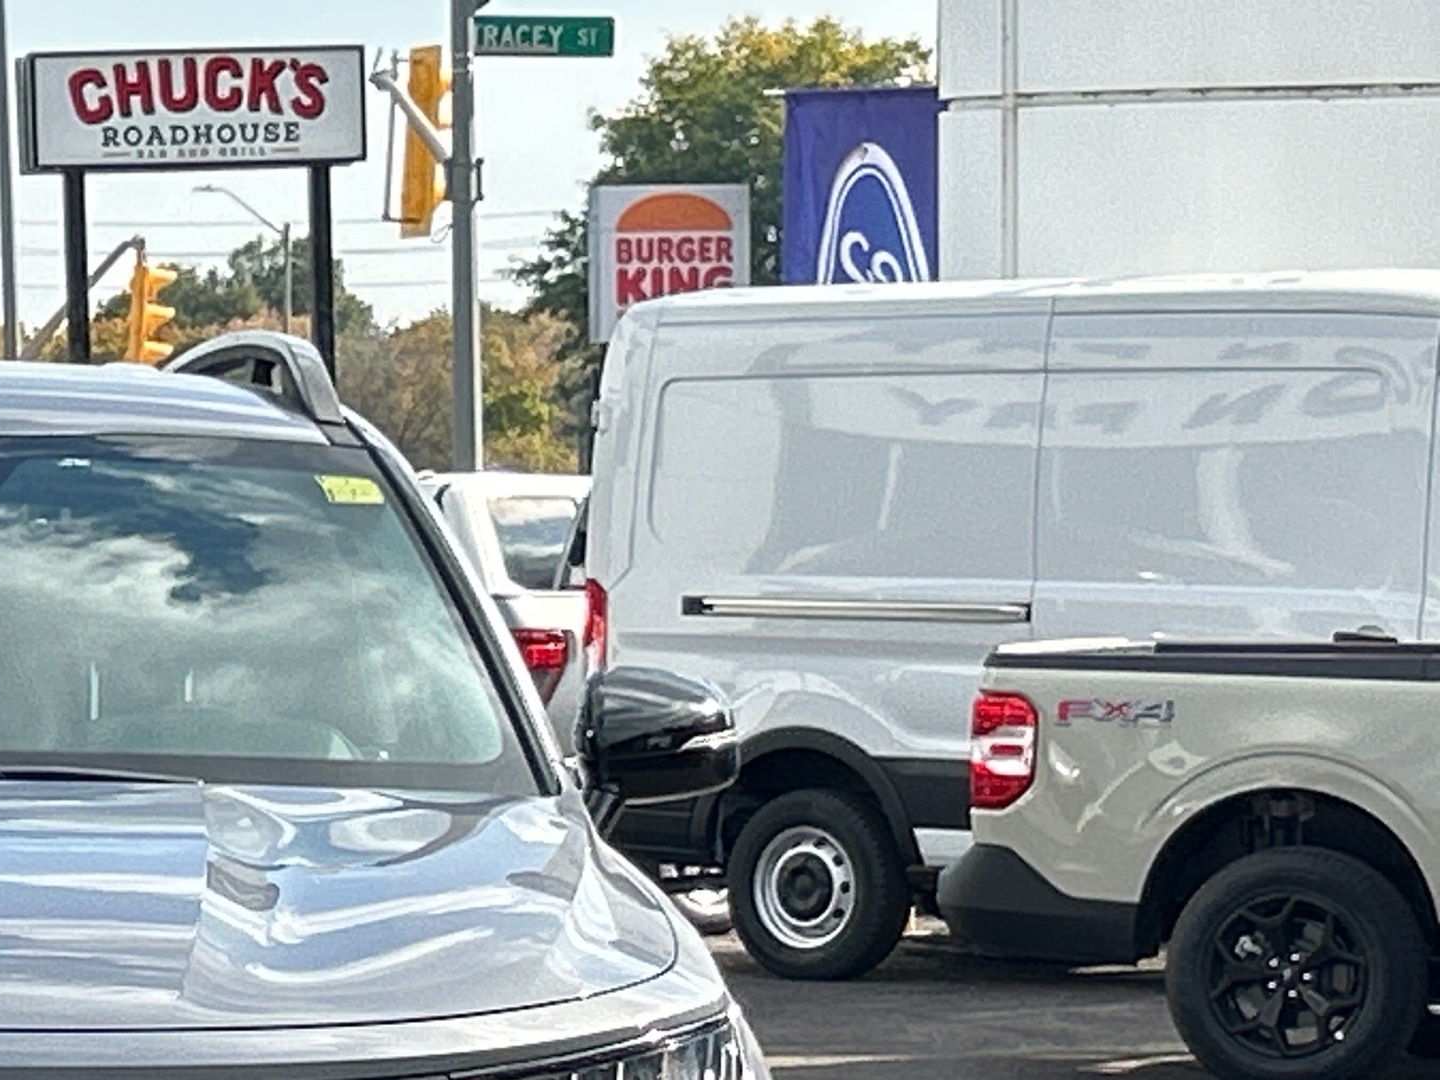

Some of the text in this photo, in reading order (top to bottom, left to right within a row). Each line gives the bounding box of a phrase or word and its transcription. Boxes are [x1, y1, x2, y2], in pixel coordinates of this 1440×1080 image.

[577, 28, 598, 46] ST
[68, 56, 329, 124] CHUCK'S
[101, 122, 301, 147] ROADHOUSE
[615, 236, 734, 265] BURGER
[1056, 699, 1174, 724] FX4
